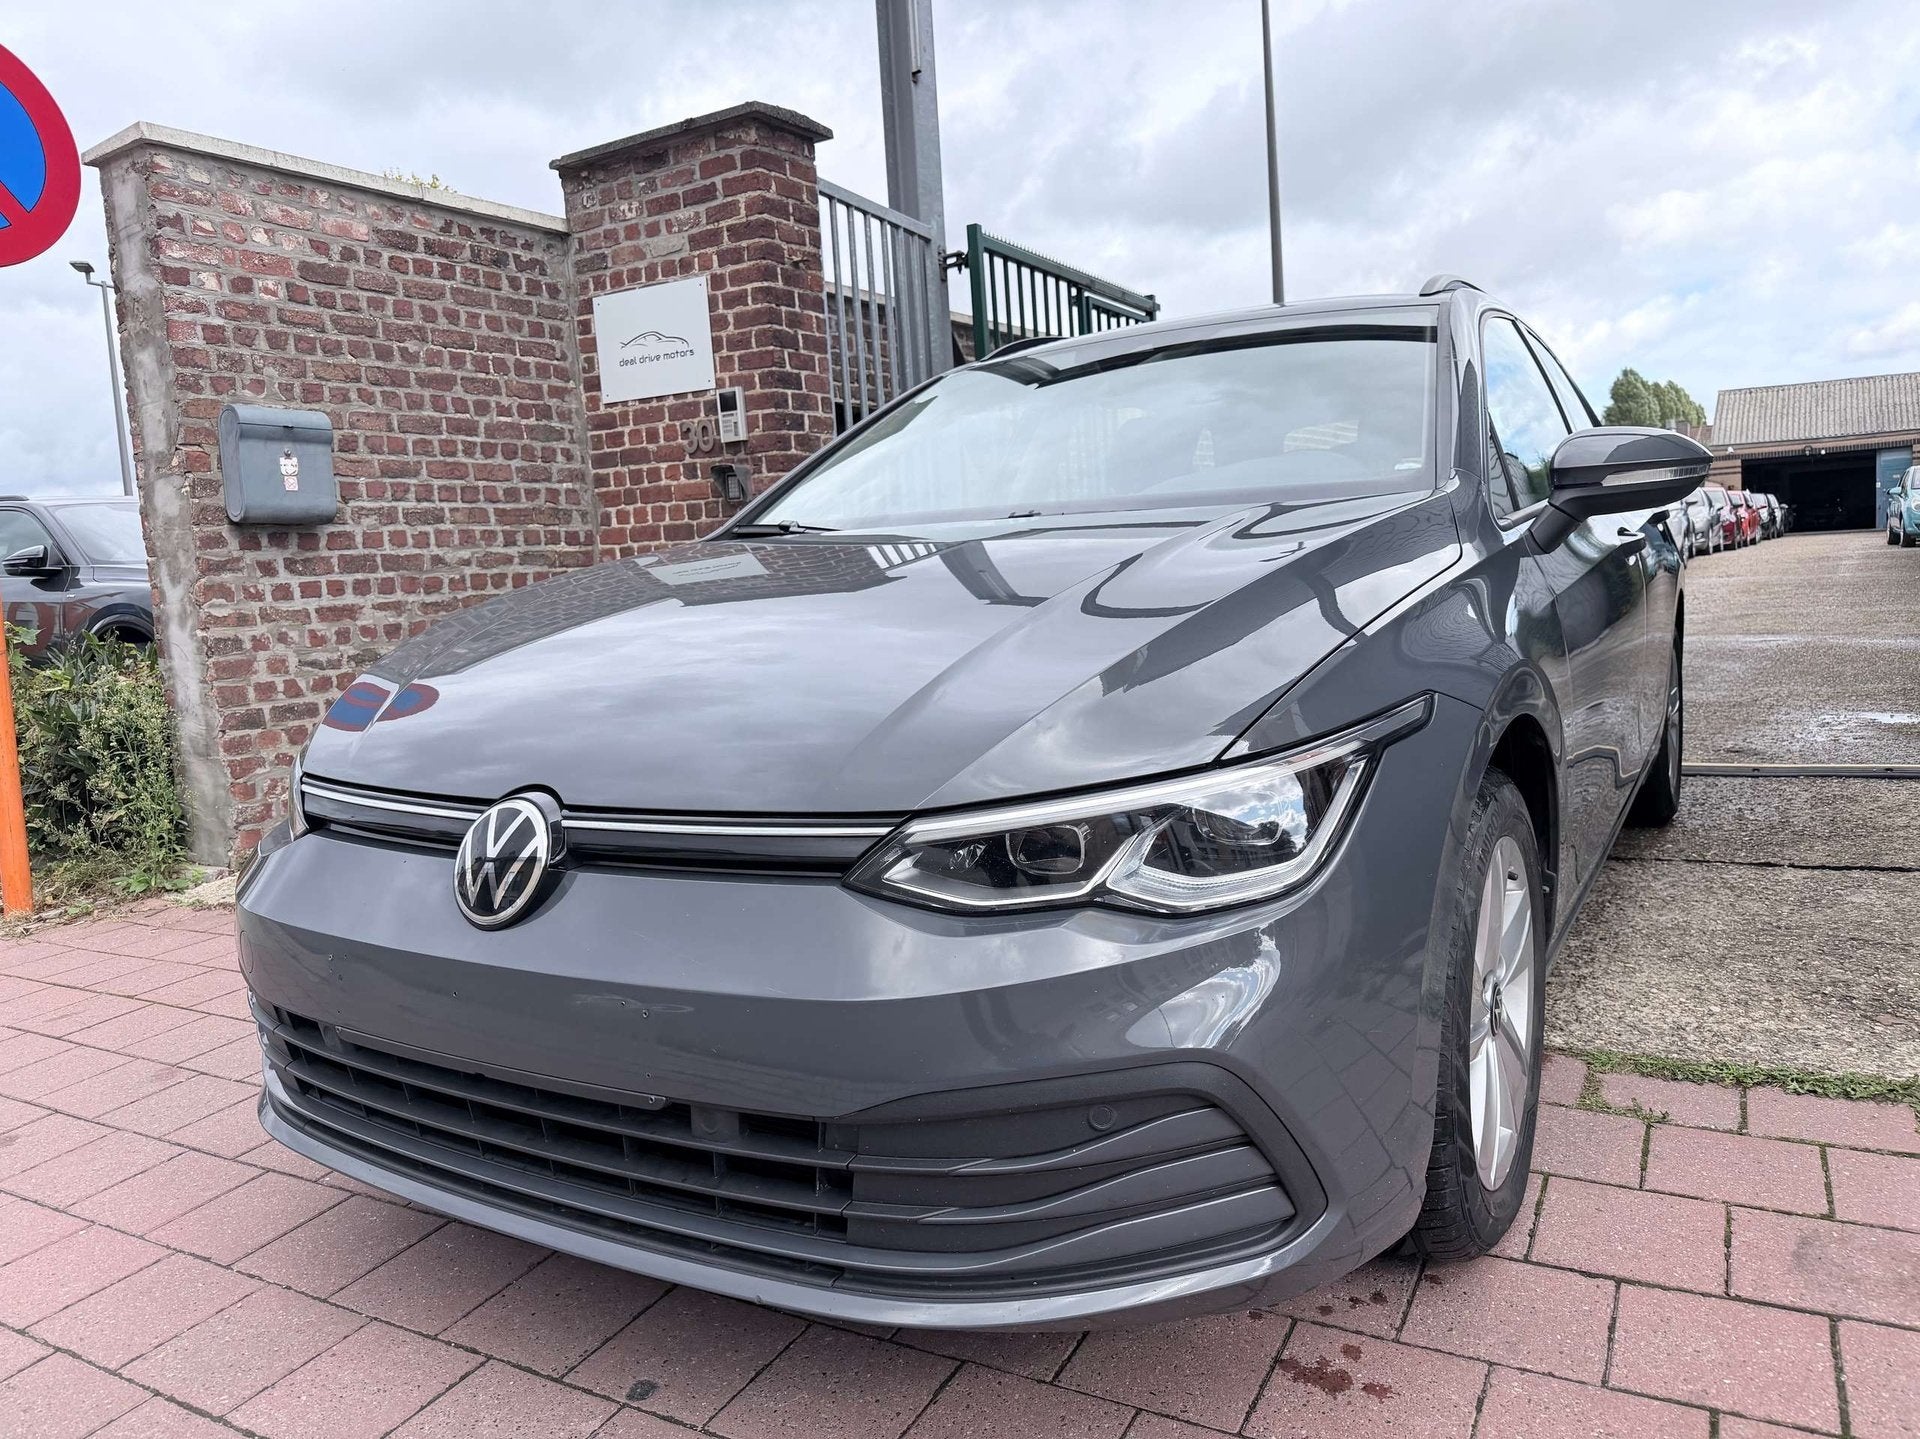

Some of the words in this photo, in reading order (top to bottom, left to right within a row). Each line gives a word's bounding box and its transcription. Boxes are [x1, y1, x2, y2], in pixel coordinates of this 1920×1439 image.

[639, 353, 661, 364] drive
[663, 349, 695, 360] motors
[680, 420, 714, 454] 30
[457, 800, 547, 920] VW
